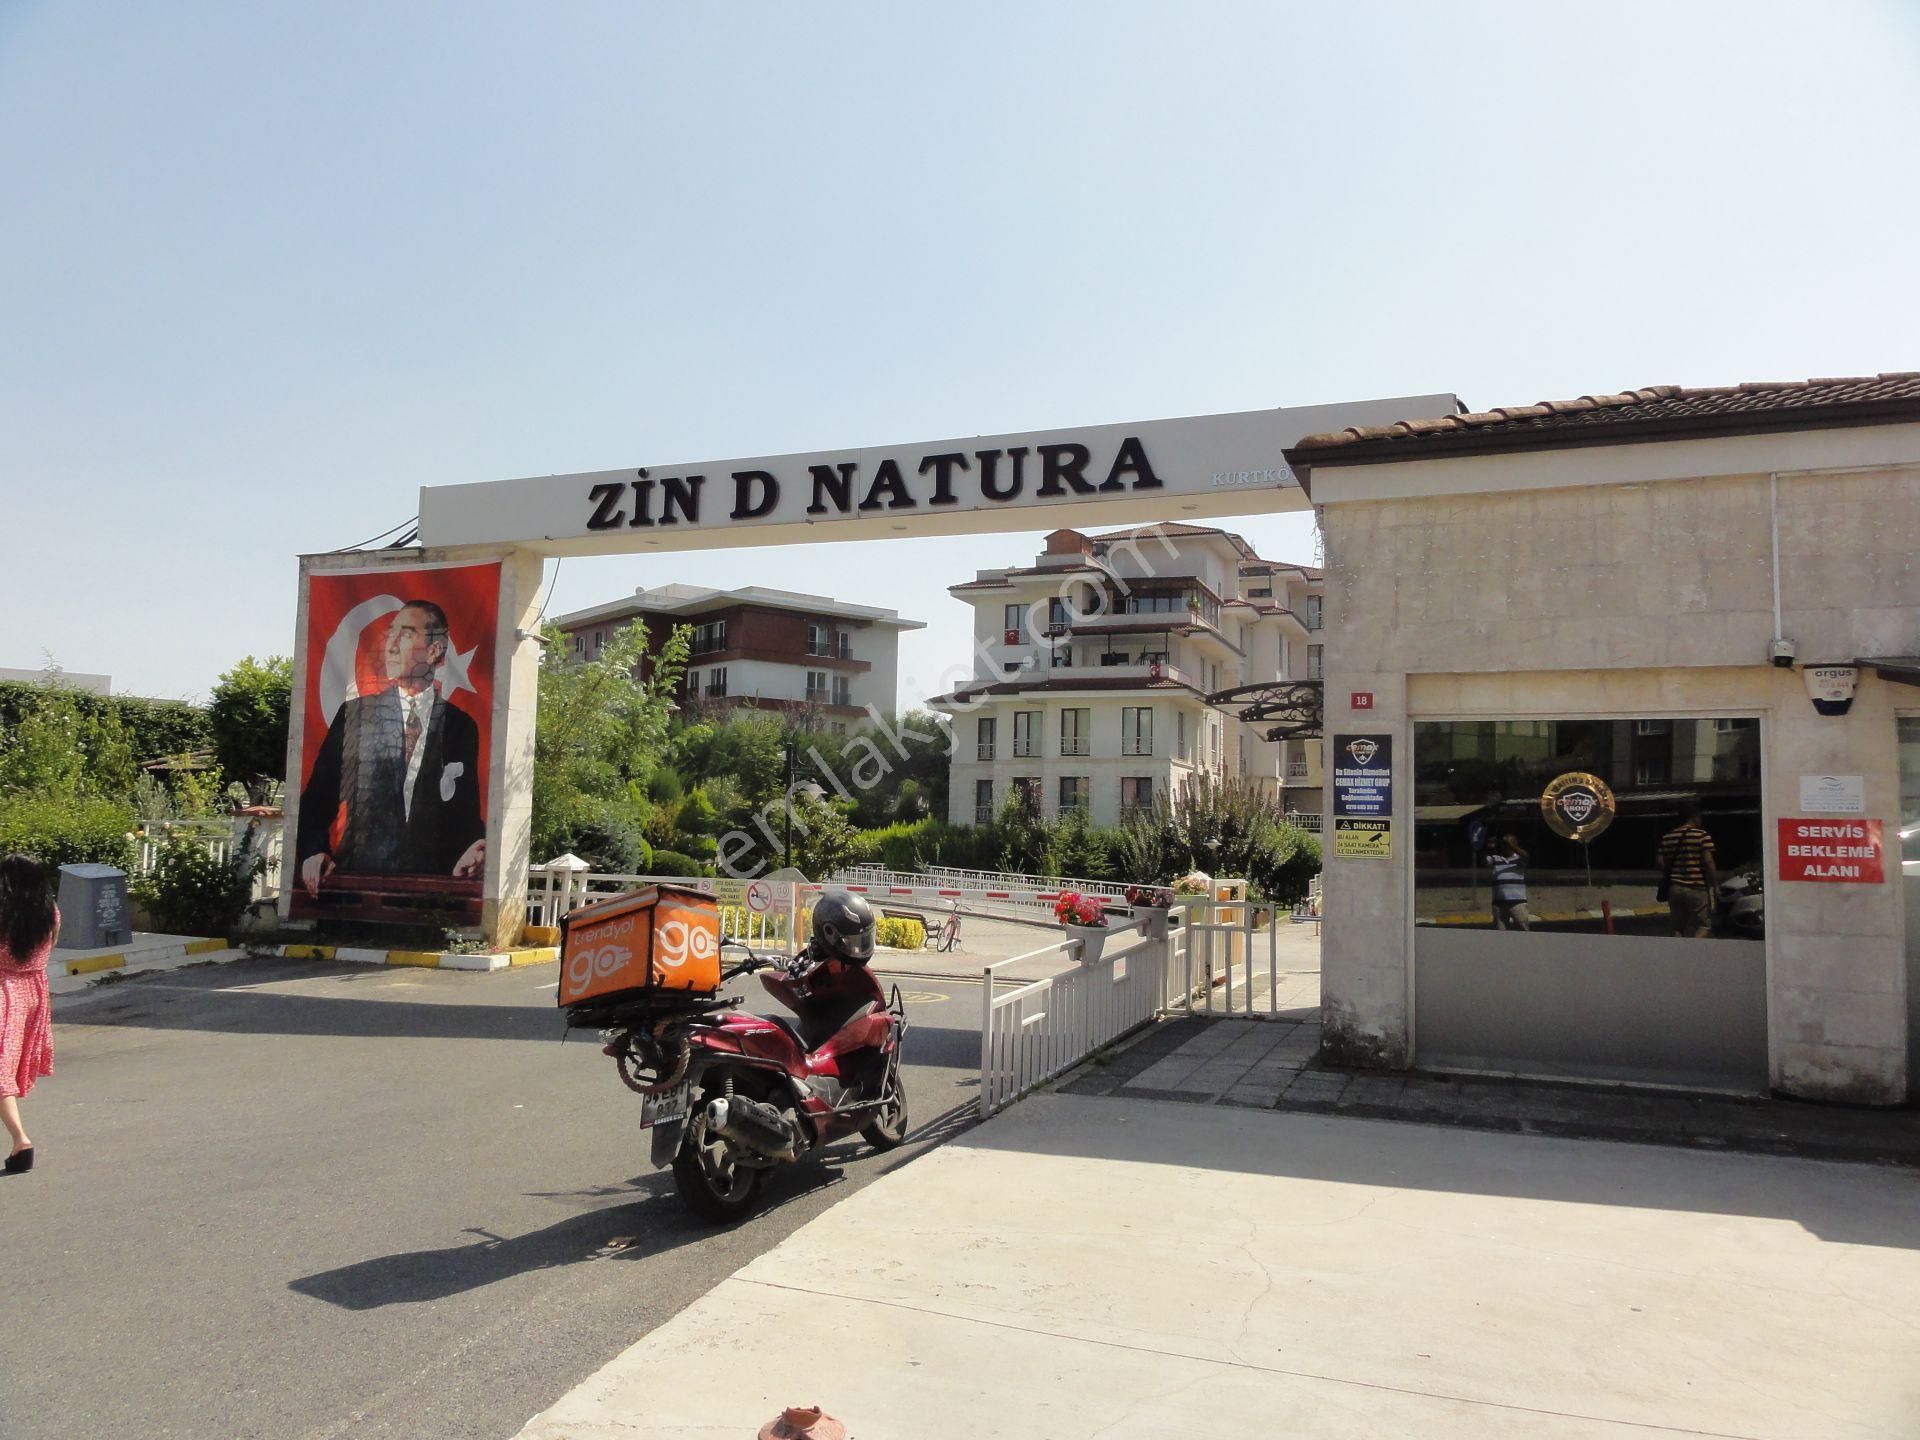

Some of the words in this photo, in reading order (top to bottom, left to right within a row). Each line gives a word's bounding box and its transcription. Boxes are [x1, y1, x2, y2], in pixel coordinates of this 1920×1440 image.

[587, 467, 704, 530] ZİN
[730, 470, 780, 520] D
[806, 437, 1163, 515] NATURA
[1210, 465, 1290, 486] KURTKÖ
[1356, 696, 1368, 705] 18
[1353, 821, 1385, 830] DİKKAT!
[1797, 824, 1864, 838] SERVİS
[1787, 845, 1875, 858] BEKLEME
[1804, 864, 1860, 877] ALANI
[574, 918, 635, 946] trendyol
[659, 920, 719, 967] go
[569, 944, 632, 995] go
